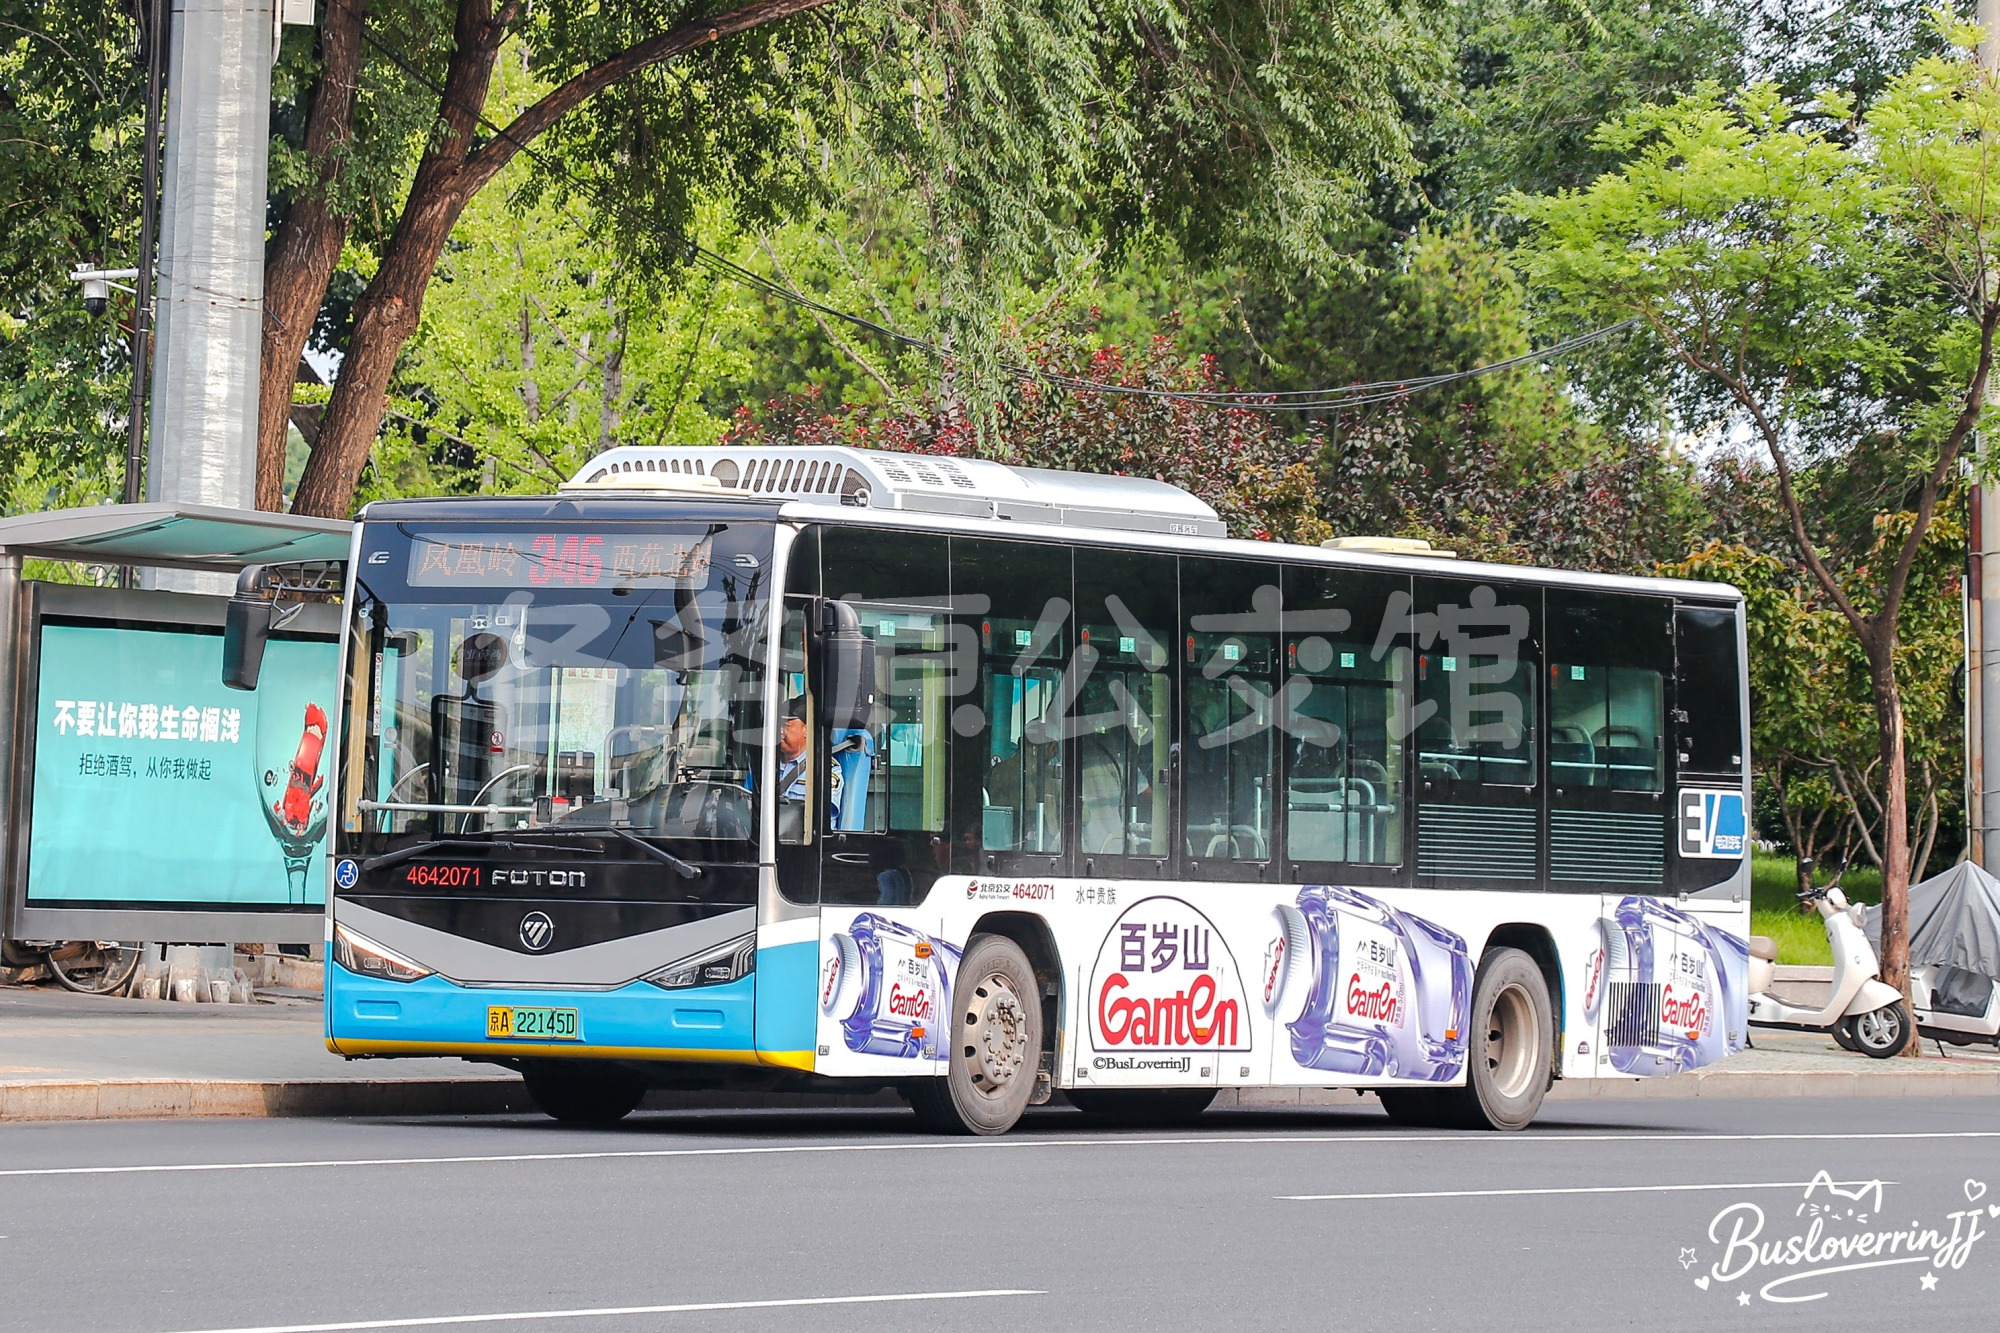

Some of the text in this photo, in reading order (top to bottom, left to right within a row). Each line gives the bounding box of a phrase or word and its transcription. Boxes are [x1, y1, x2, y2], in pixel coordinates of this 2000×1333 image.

[417, 542, 521, 577] 凤凰岭
[528, 536, 605, 584] 346
[53, 699, 241, 744] 不要让你我生命搁浅
[79, 752, 212, 781] 拒绝酒驾，从你我做起
[1681, 793, 1722, 854] EV
[406, 866, 480, 886] 4642071
[491, 869, 586, 888] FOTON
[980, 883, 1055, 900] 北京公交 4642071
[1075, 885, 1117, 905] 水中贵族
[1120, 922, 1209, 974] 百岁山
[1370, 940, 1396, 968] 百岁山
[908, 958, 928, 979] 百岁山
[1681, 952, 1704, 979] 百岁山
[889, 982, 929, 1020] Ganten
[1098, 972, 1238, 1046] Ganten
[1347, 972, 1397, 1024] Ganten
[1661, 983, 1706, 1031] Ganten
[490, 1011, 575, 1034] 京A 22145D
